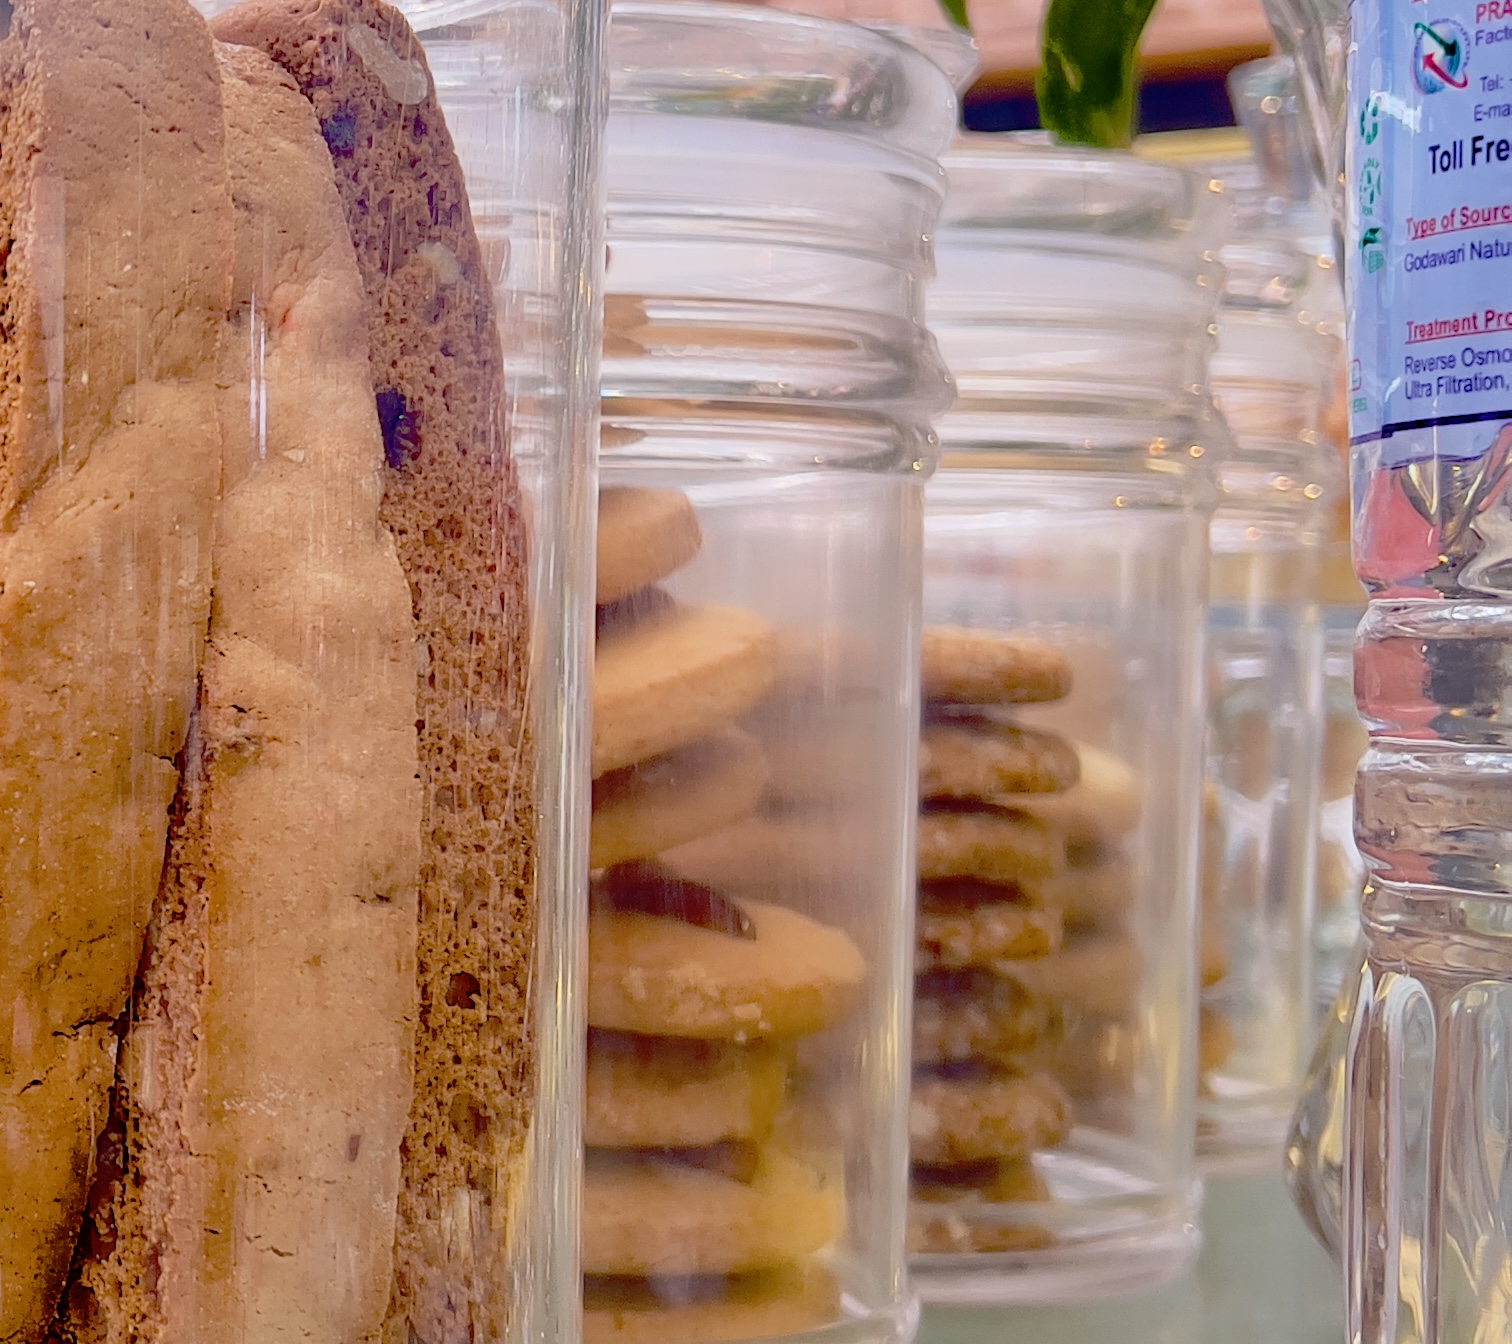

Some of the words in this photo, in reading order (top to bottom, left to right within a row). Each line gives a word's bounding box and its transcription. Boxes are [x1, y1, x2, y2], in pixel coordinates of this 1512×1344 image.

[1480, 74, 1504, 92] Tel:
[1429, 139, 1464, 174] Toll
[1406, 218, 1437, 240] Type
[1441, 208, 1457, 230] of
[1404, 243, 1465, 272] Godawari
[1406, 312, 1478, 341] Treatment
[1404, 355, 1456, 374] Reverse
[1405, 381, 1433, 400] Ultra
[1436, 372, 1509, 395] Filtration,
